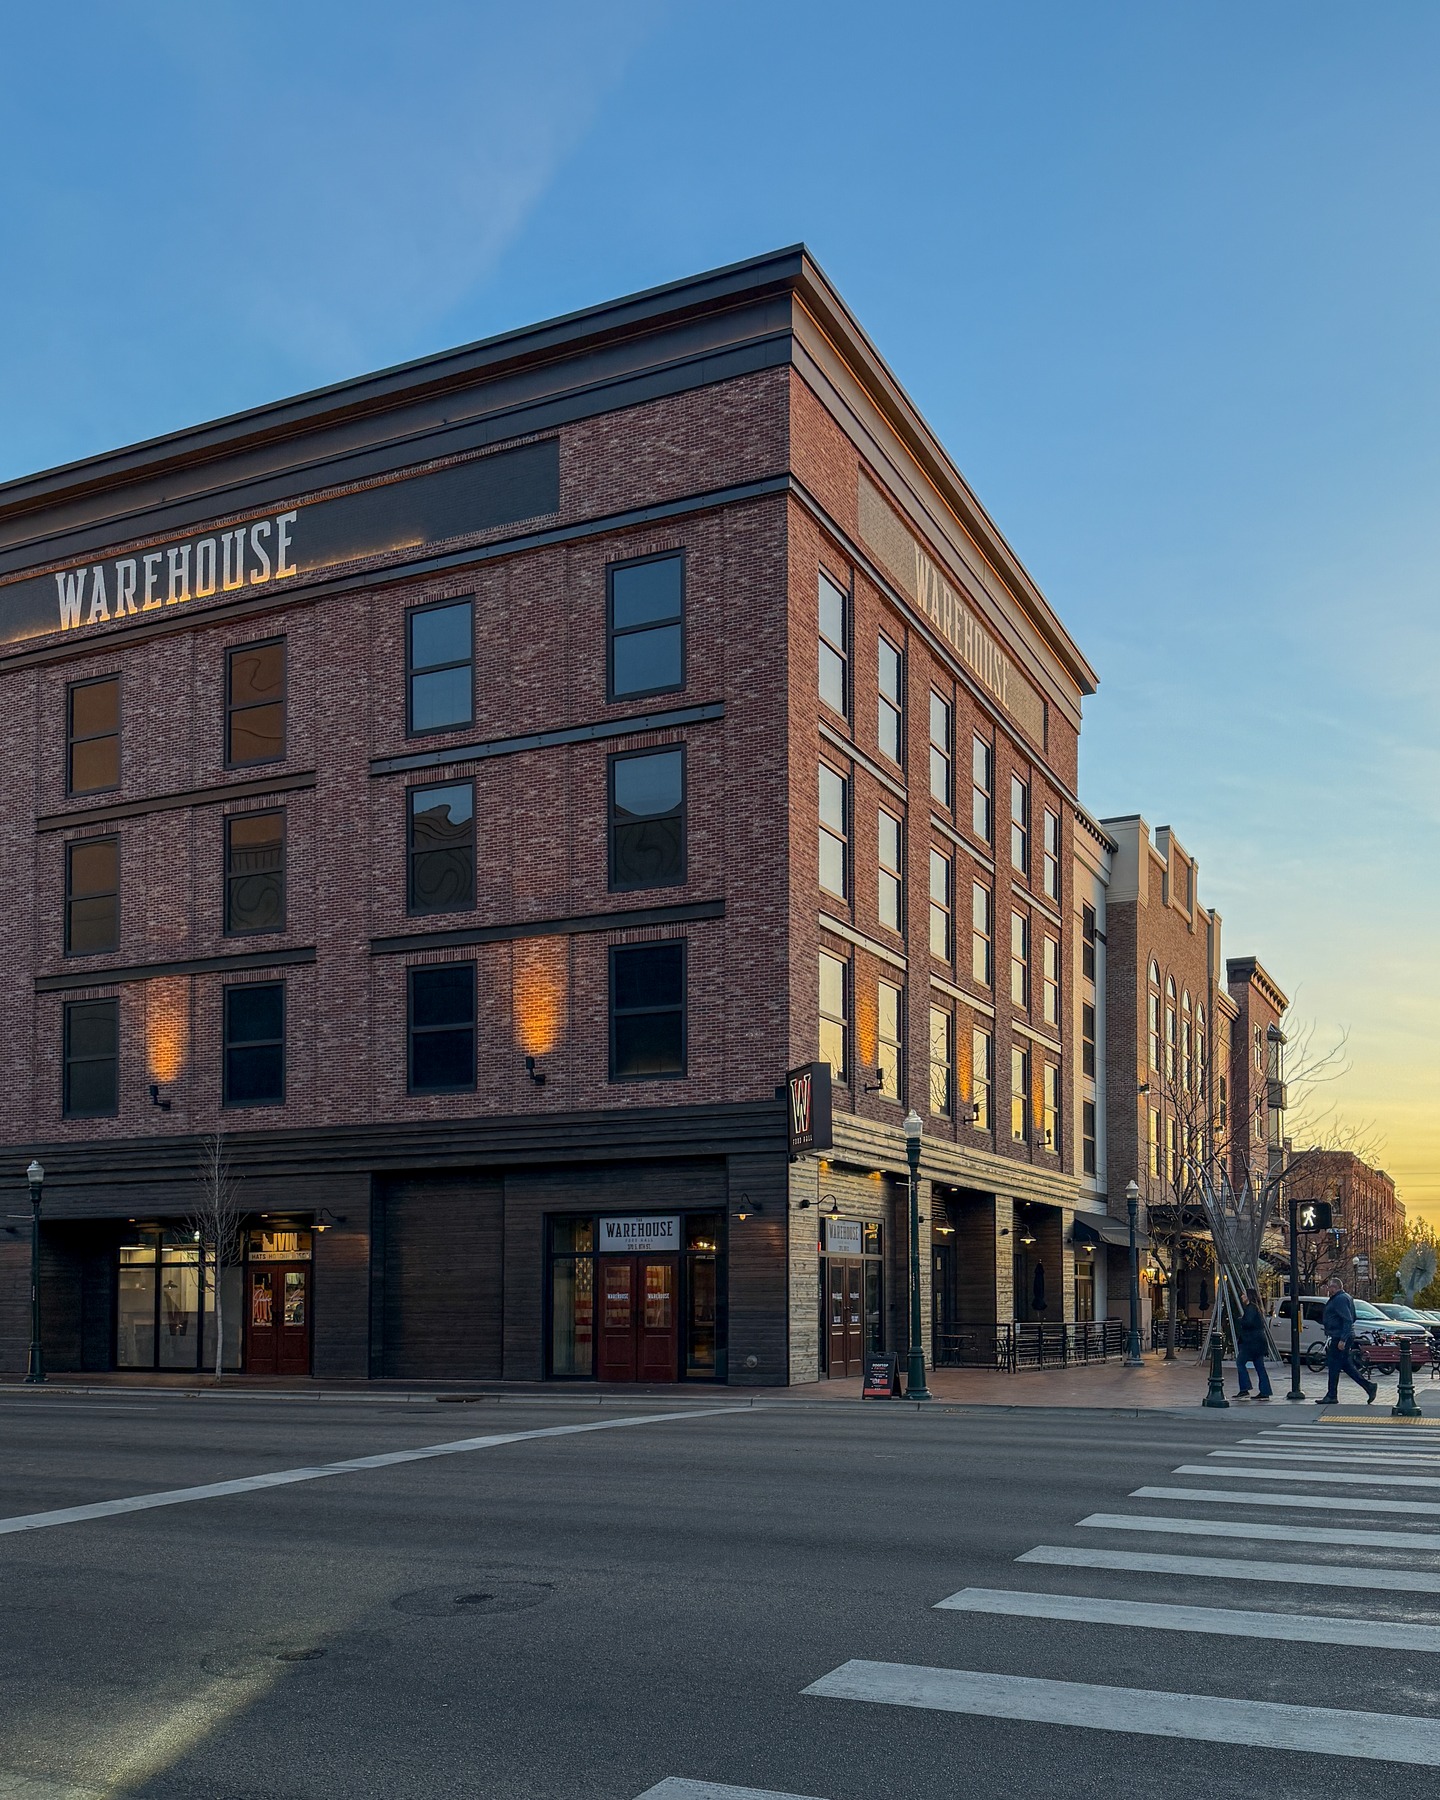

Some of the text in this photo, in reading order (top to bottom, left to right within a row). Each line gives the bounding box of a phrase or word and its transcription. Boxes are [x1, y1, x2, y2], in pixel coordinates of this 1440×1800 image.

[55, 510, 297, 630] WAREHOUSE
[914, 541, 1010, 709] WAREHOUSE
[790, 1073, 811, 1134] W
[606, 1221, 673, 1238] WAREHOUSE
[828, 1223, 859, 1241] WAREHOUSE
